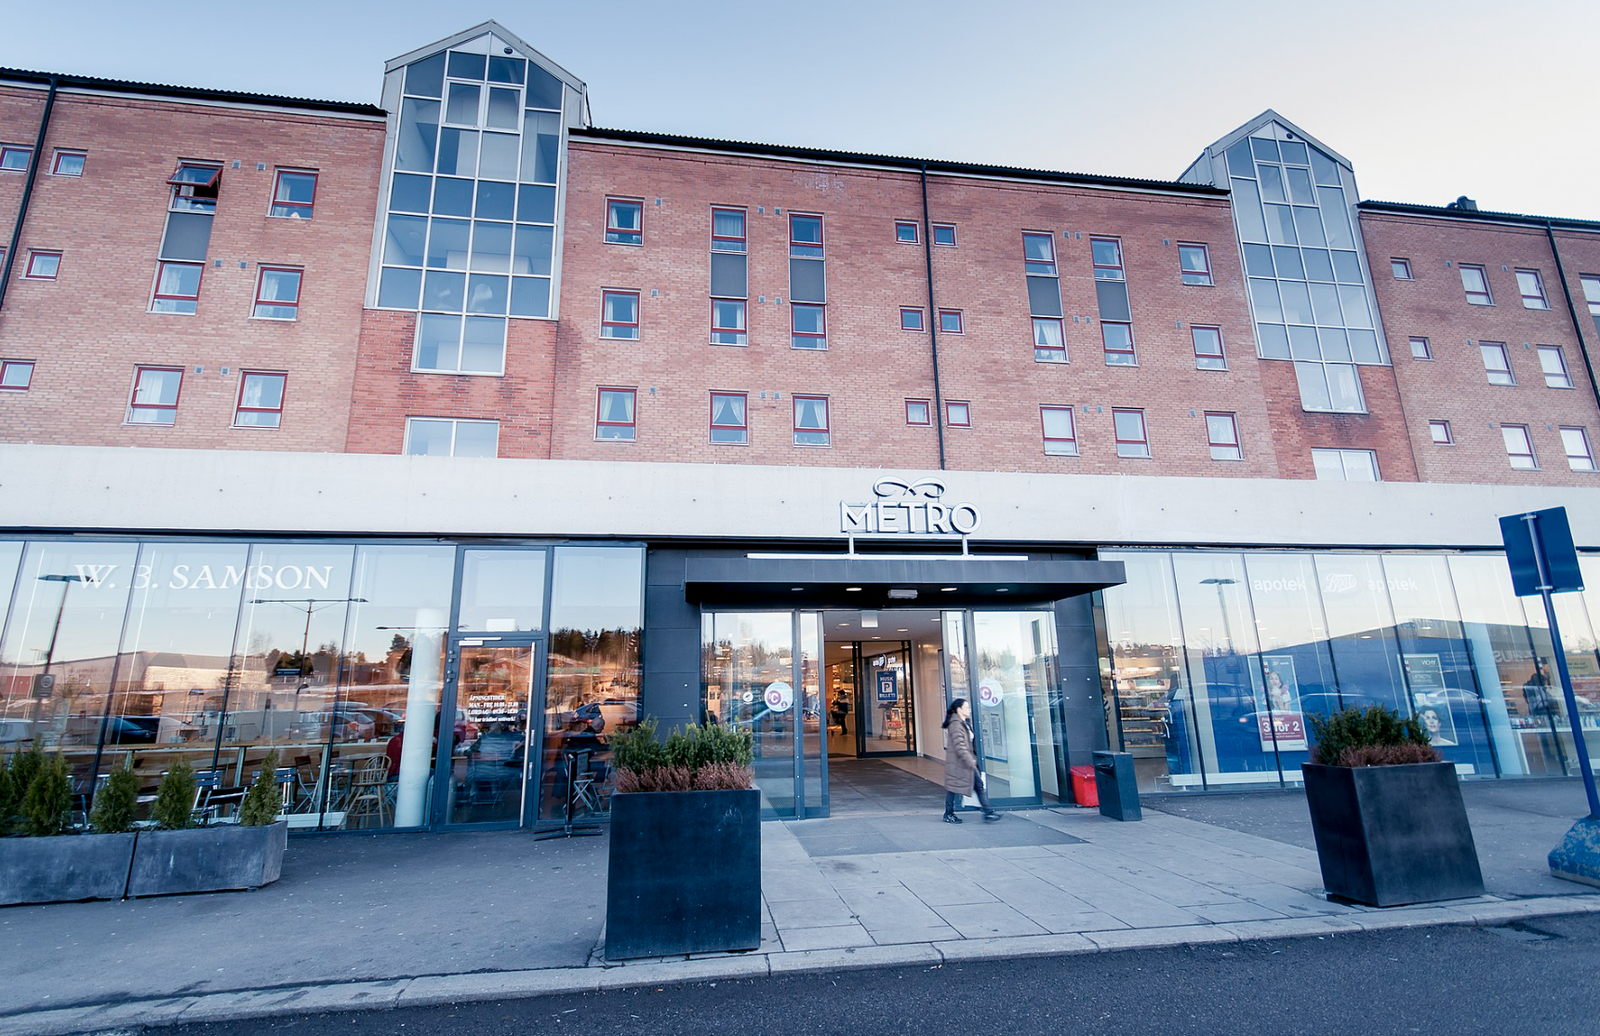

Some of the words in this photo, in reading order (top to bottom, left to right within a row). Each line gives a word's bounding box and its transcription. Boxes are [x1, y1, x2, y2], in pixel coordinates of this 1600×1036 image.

[840, 500, 982, 534] METRO
[74, 564, 116, 589] W.
[169, 564, 334, 590] SAMSON
[1254, 577, 1305, 593] apotek
[1368, 577, 1418, 593] apotek
[1263, 721, 1270, 732] 3
[1292, 720, 1300, 732] 2
